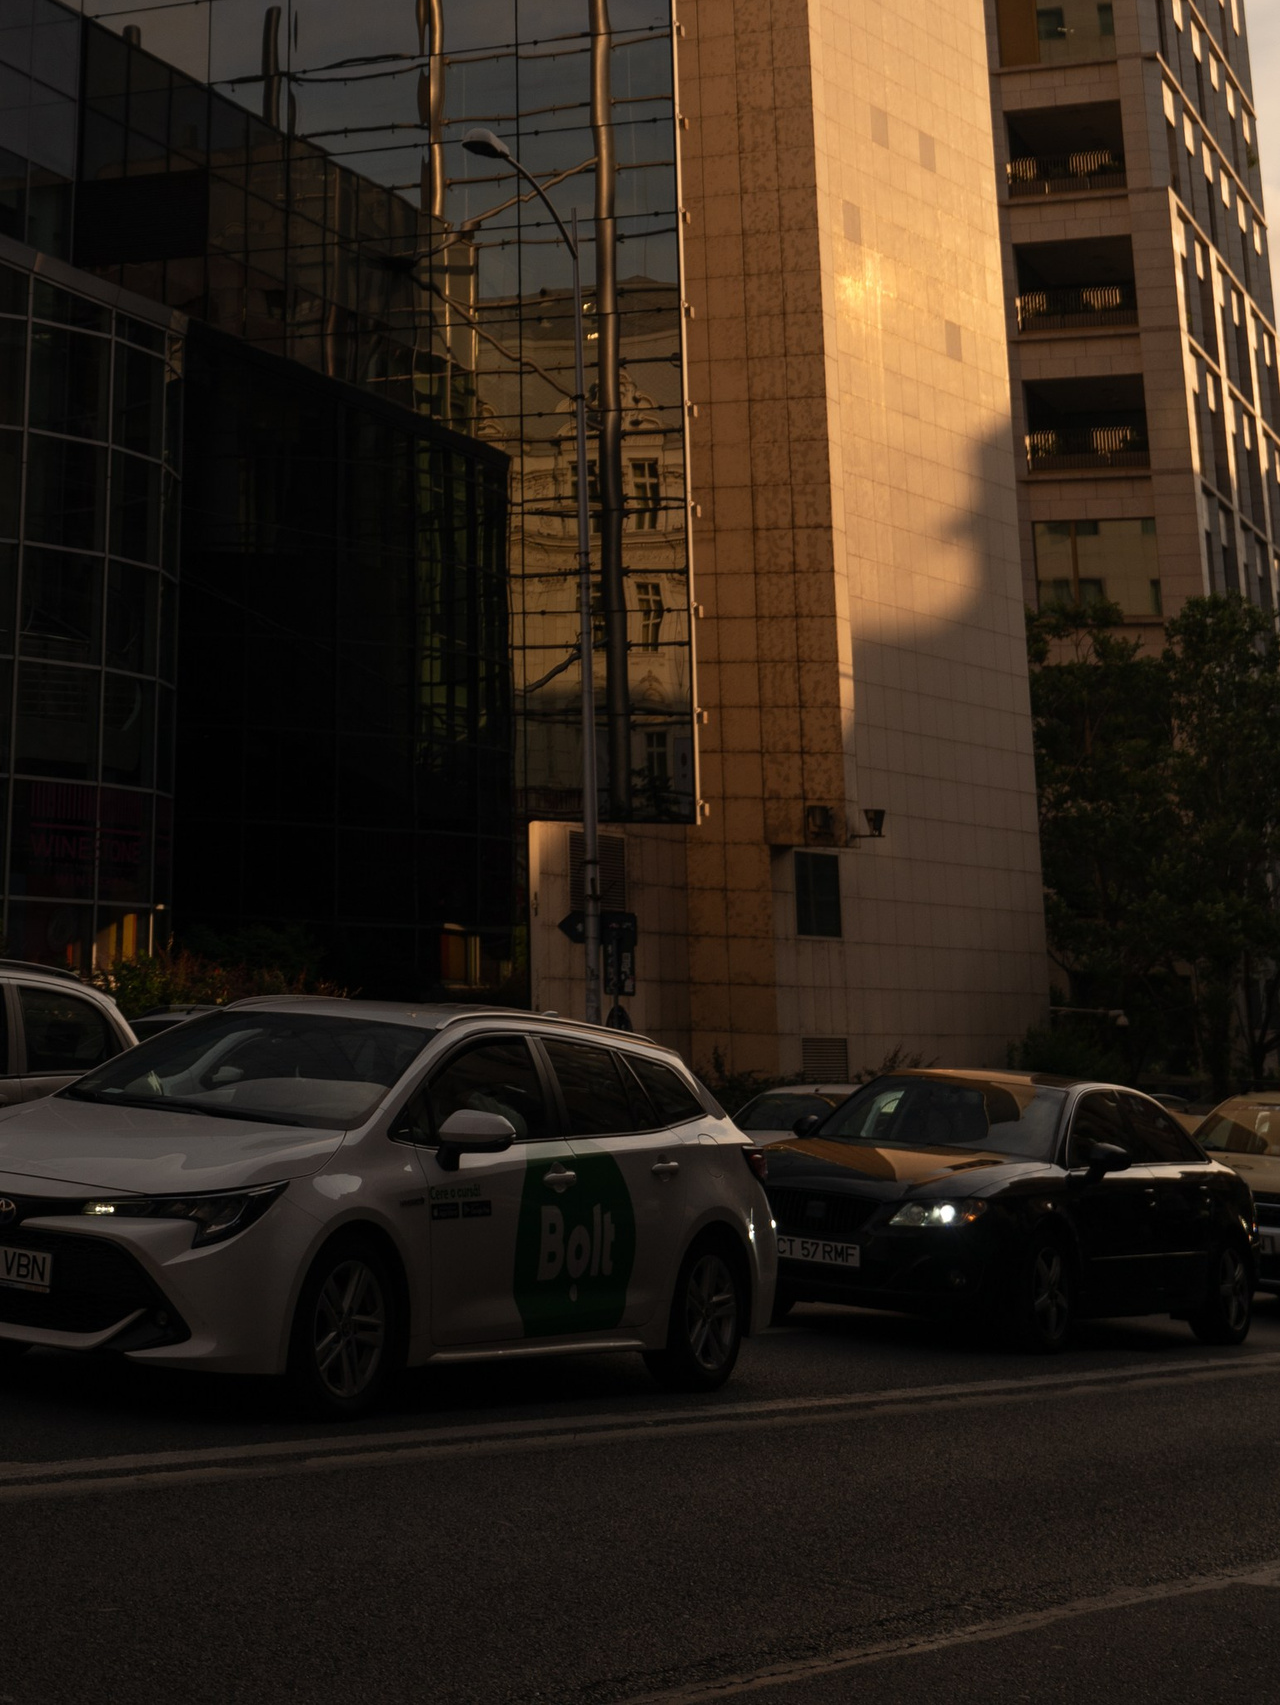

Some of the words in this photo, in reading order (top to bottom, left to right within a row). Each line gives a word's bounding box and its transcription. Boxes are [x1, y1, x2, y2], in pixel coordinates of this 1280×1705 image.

[535, 1202, 617, 1283] Bolt
[776, 1237, 796, 1256] CT
[801, 1240, 820, 1259] 57
[822, 1243, 857, 1263] RMF
[4, 1249, 47, 1282] VBN
